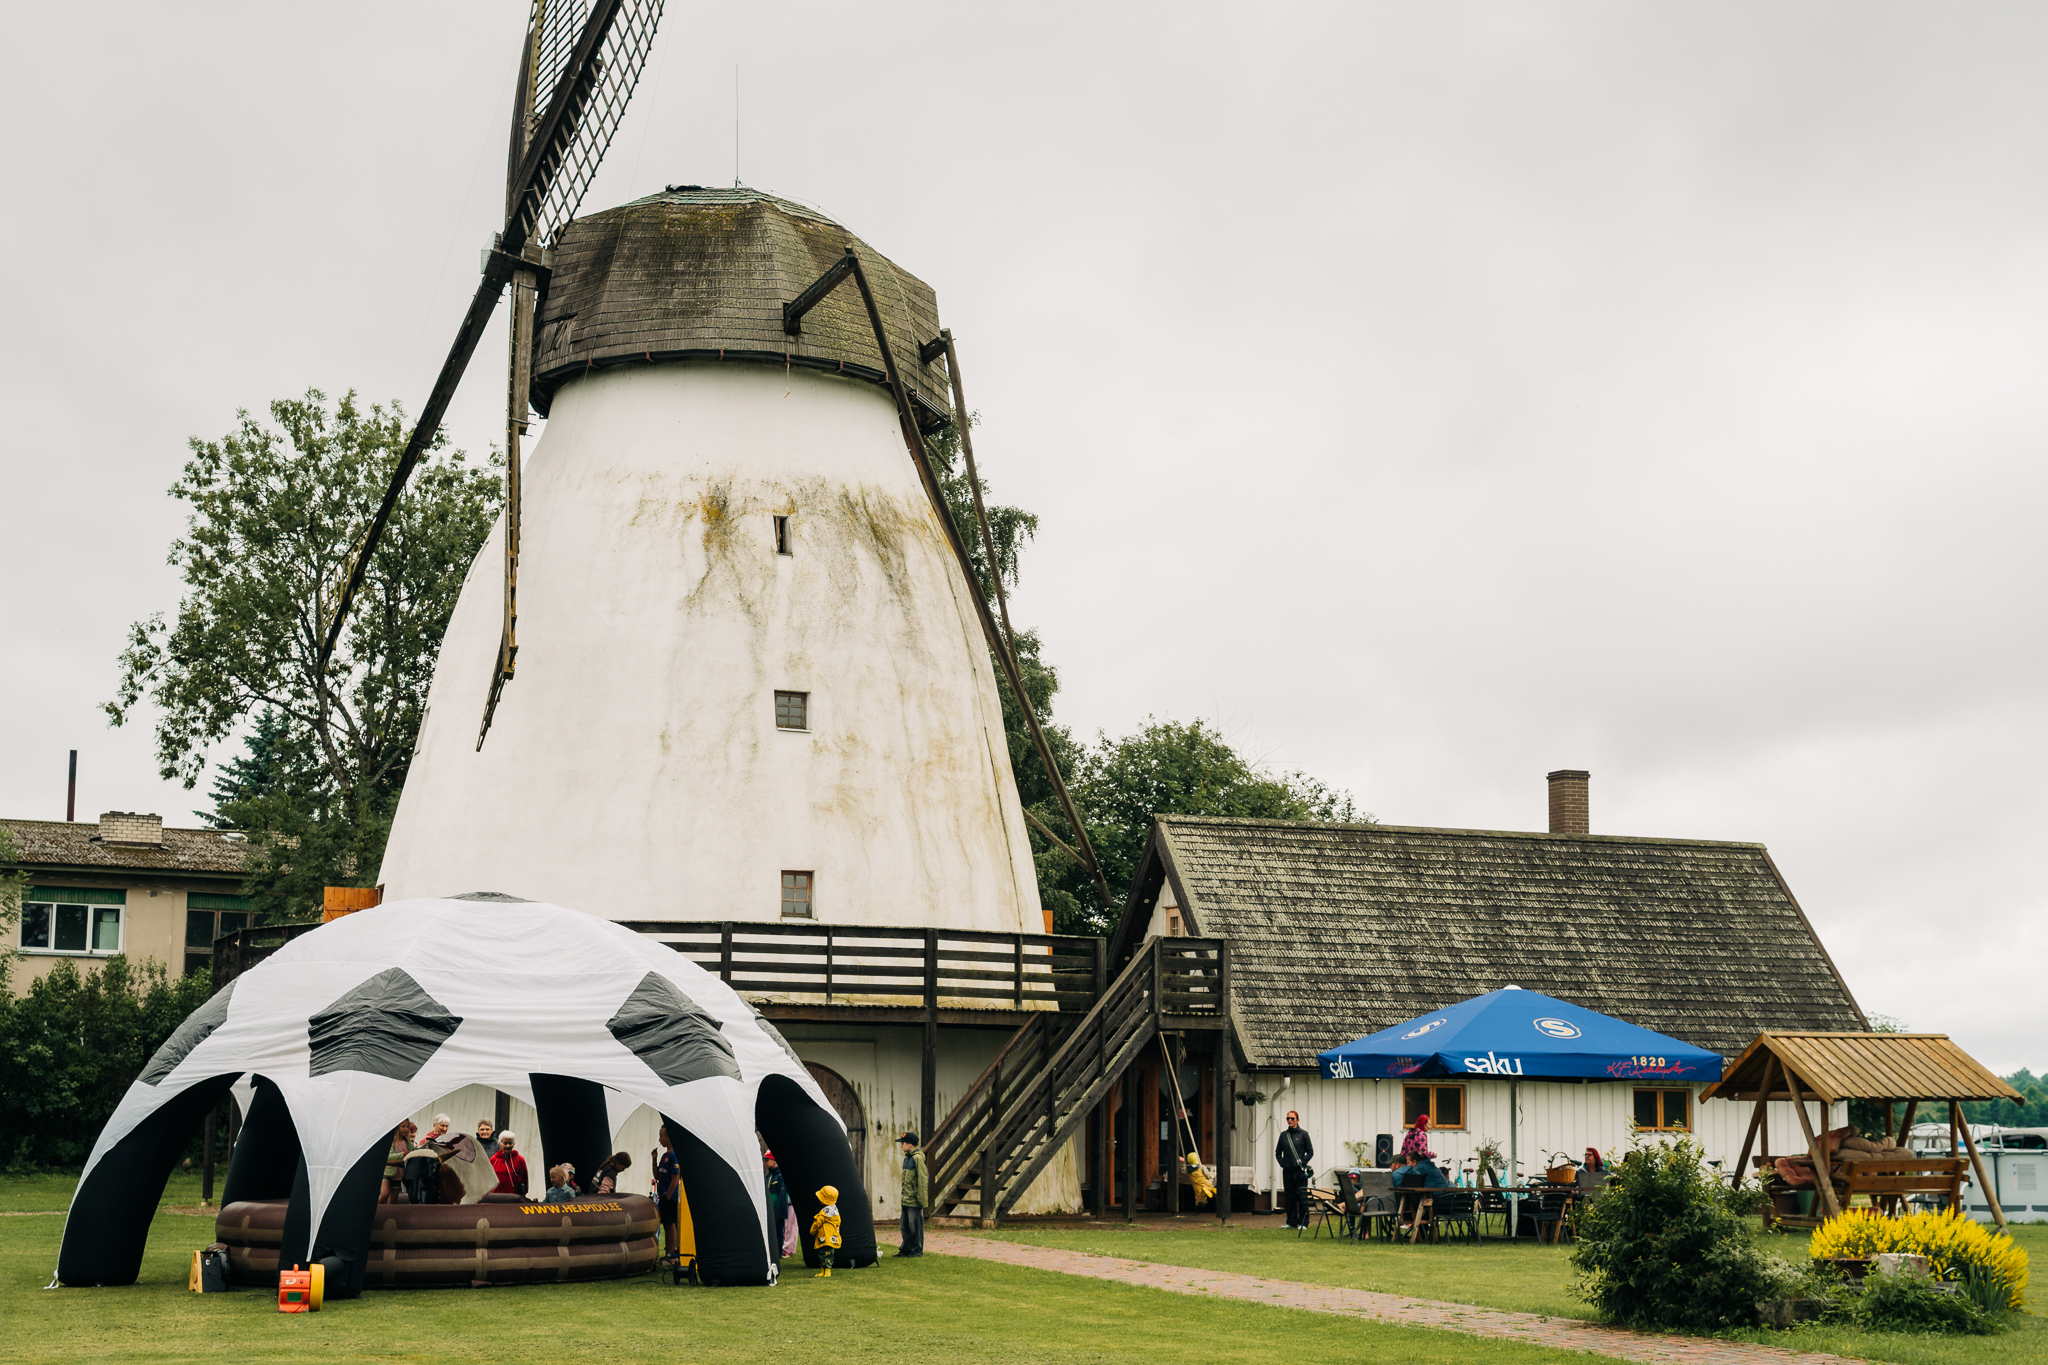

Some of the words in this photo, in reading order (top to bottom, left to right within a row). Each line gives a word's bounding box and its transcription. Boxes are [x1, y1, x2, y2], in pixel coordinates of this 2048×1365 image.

[1464, 1051, 1523, 1075] saku
[1631, 1056, 1666, 1067] 1820
[520, 1202, 622, 1214] WWW.HEAPIDU.EE
